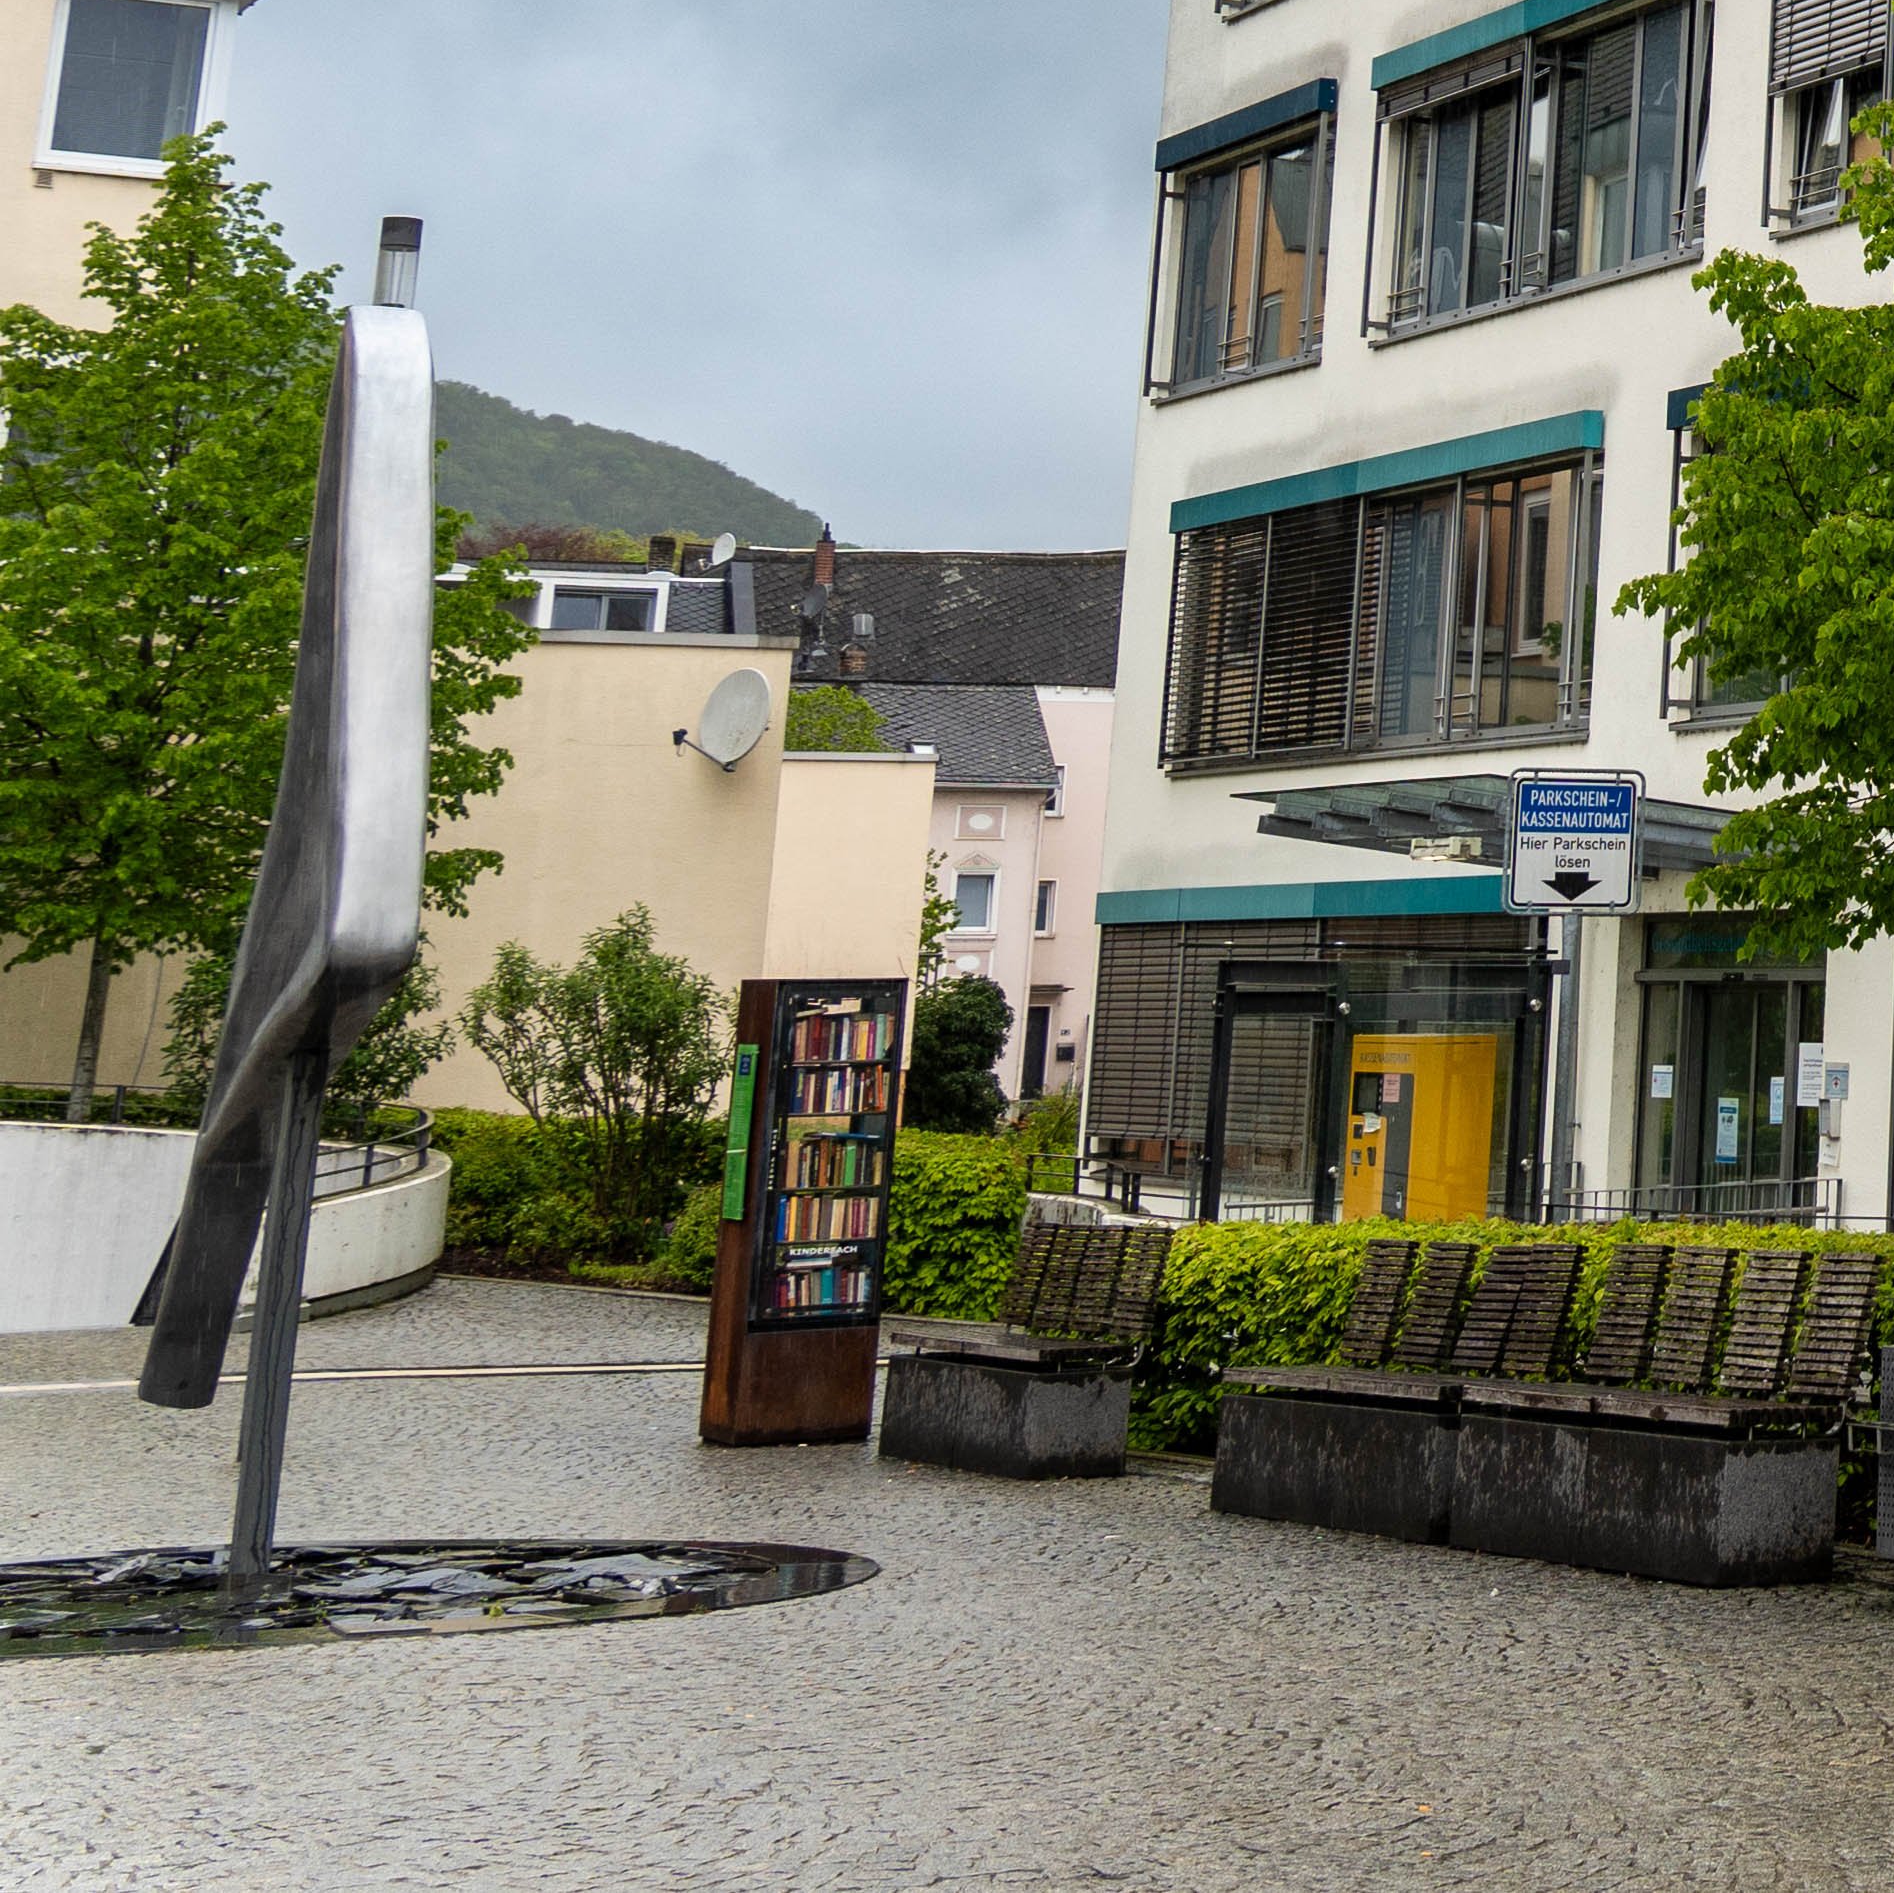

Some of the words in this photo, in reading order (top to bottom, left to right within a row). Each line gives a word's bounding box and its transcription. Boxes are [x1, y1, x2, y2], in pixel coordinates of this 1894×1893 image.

[1530, 789, 1623, 808] PARKSCHEIN-/
[1521, 810, 1629, 829] KASSENAUTOMAT
[1520, 836, 1548, 850] Hier
[1553, 836, 1626, 851] Parkschein
[1555, 854, 1591, 868] lösen
